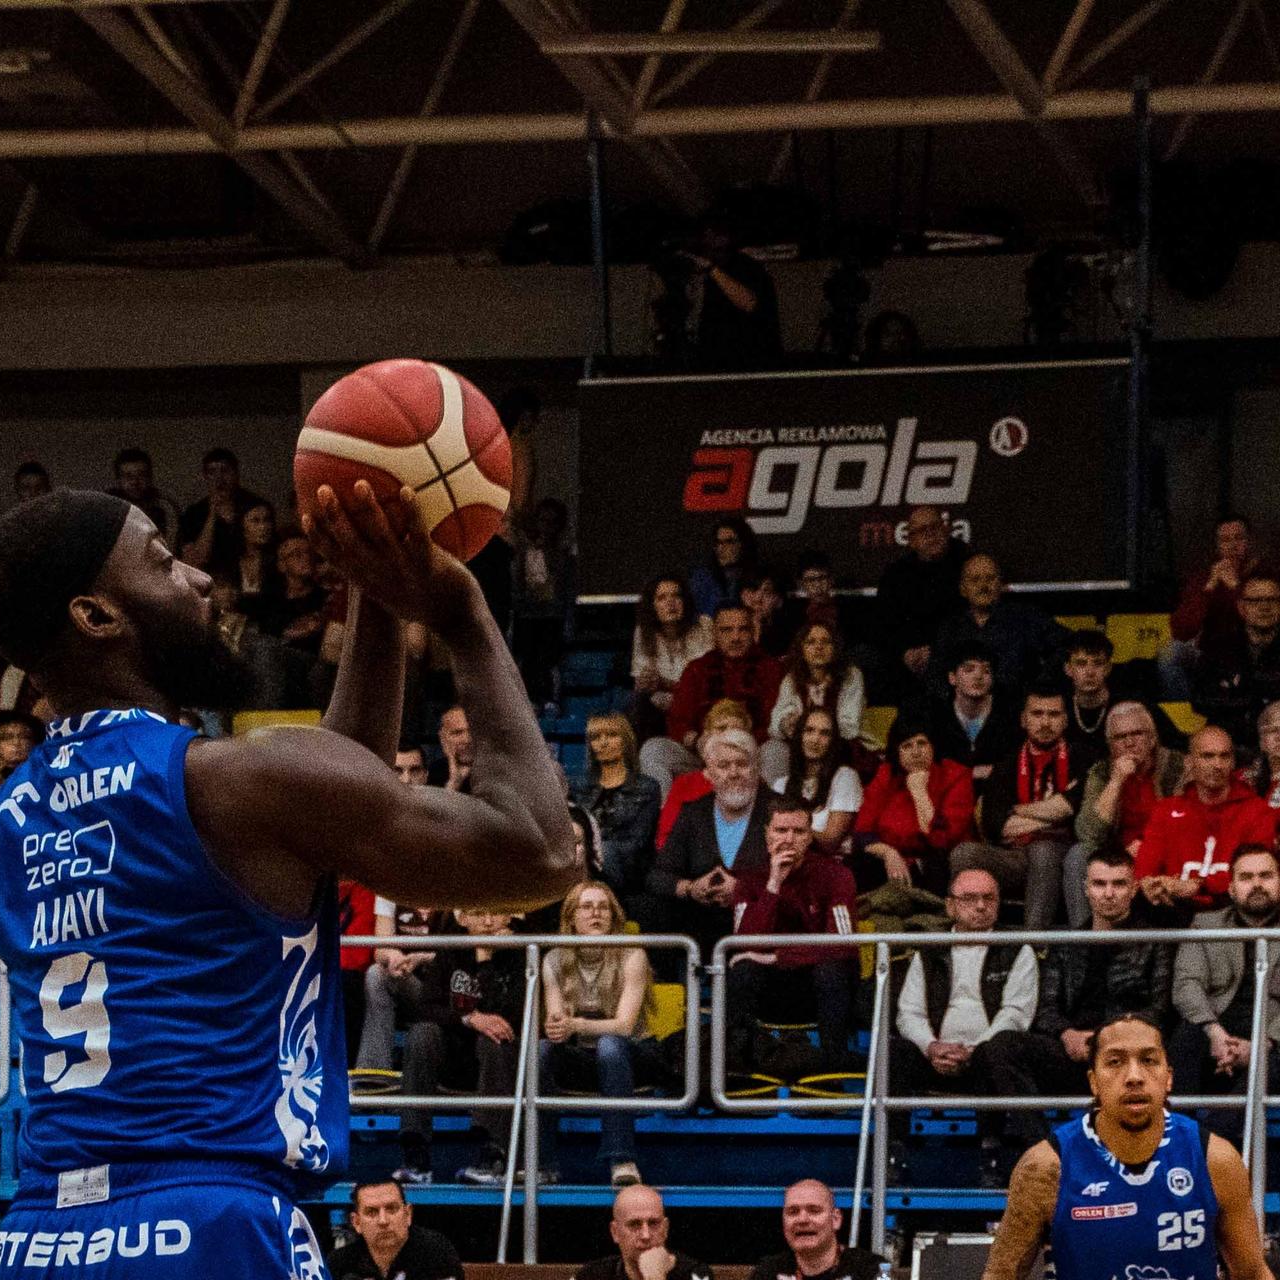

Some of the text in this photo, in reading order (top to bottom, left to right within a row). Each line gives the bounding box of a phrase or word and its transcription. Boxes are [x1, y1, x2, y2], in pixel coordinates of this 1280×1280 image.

[700, 423, 887, 446] AGENCJA REKLAMOWA
[683, 417, 978, 534] agola
[860, 511, 971, 546] mea
[49, 761, 136, 813] ORLEN
[26, 855, 94, 891] zero
[29, 887, 109, 949] AJAYI
[38, 952, 112, 1094] 9
[1156, 1209, 1206, 1251] 25
